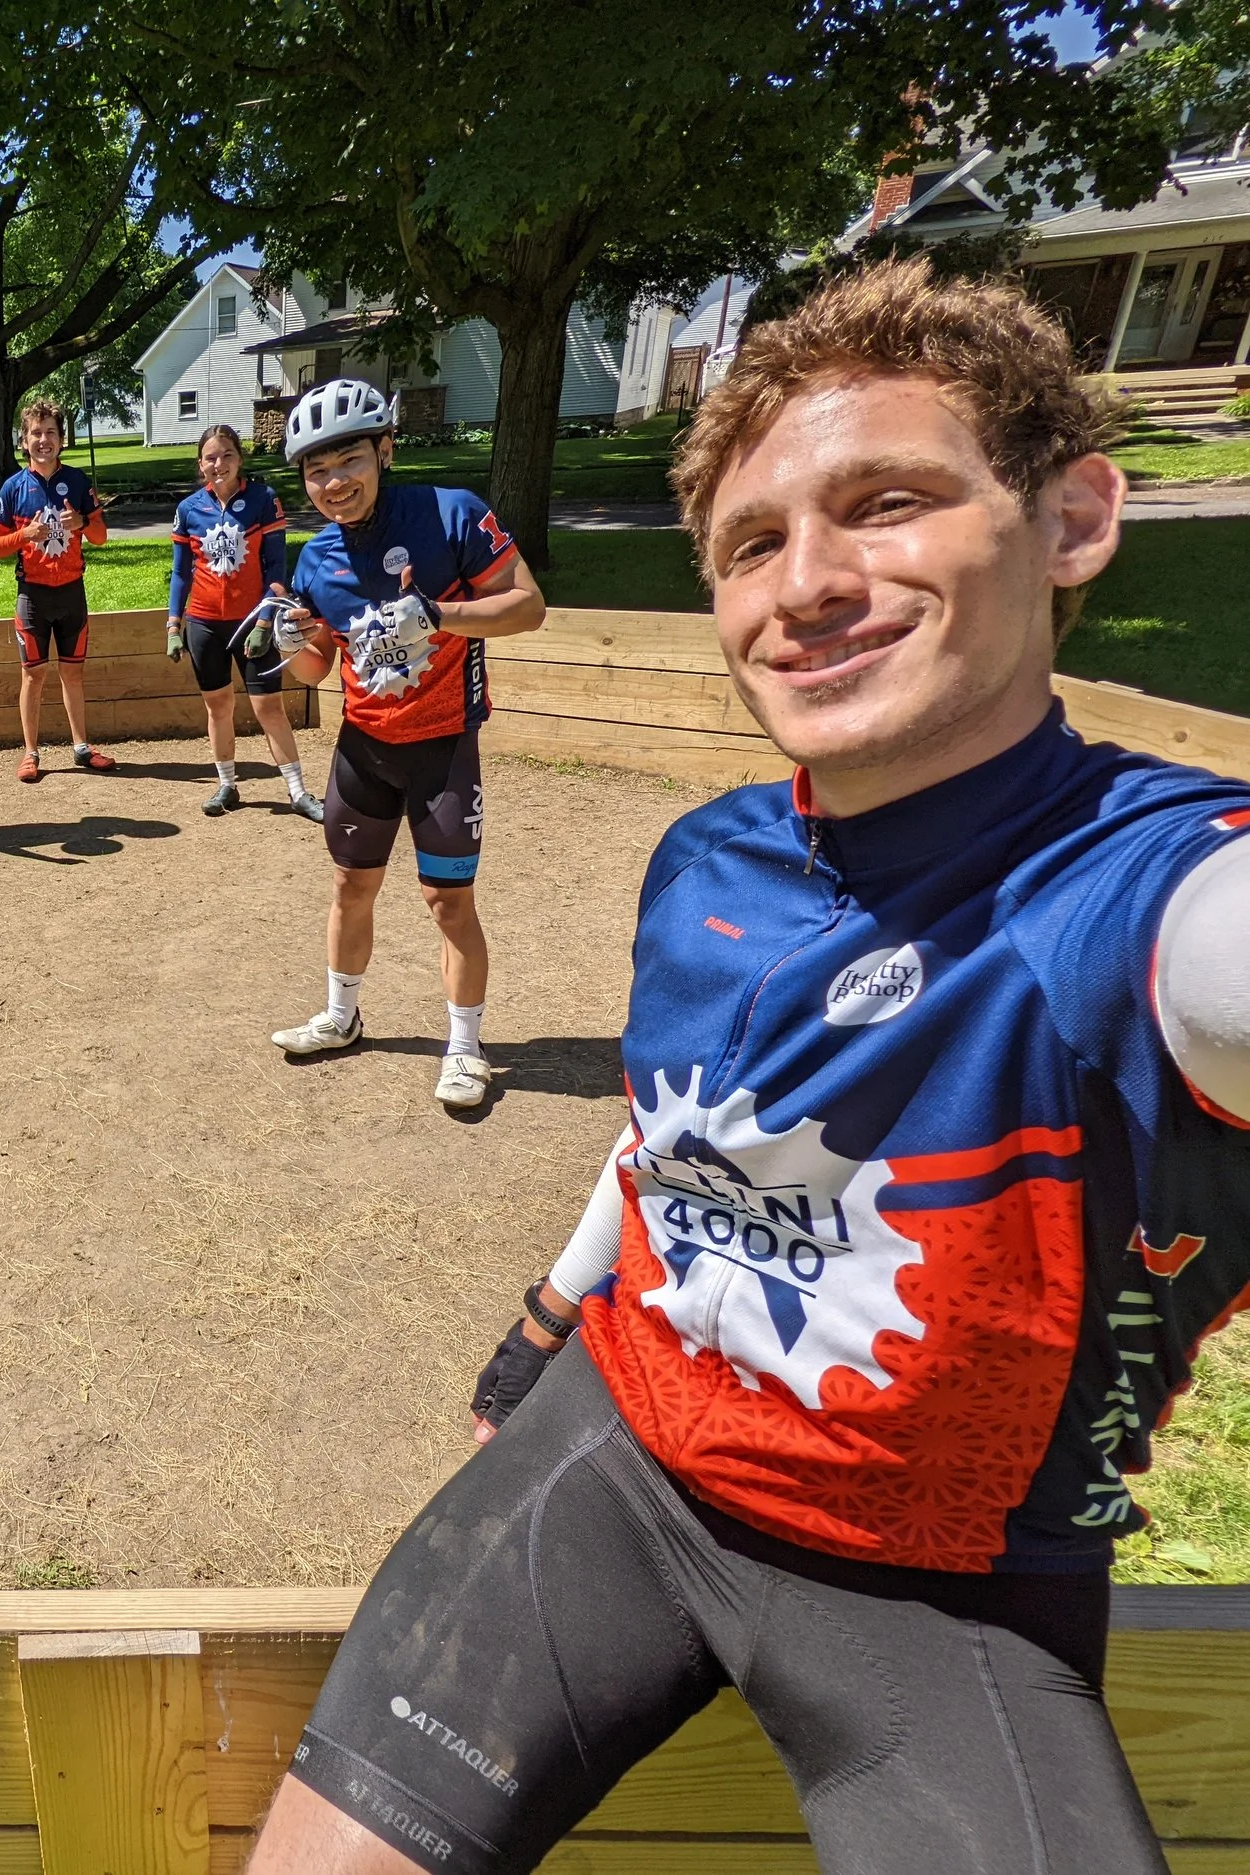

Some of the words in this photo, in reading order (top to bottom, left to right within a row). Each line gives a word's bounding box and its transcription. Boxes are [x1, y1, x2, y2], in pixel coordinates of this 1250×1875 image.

[47, 531, 65, 539] 000
[206, 539, 239, 551] ILLINI
[365, 649, 408, 668] 4000
[451, 861, 477, 876] Rap
[703, 915, 747, 942] PRIMAL
[663, 1197, 825, 1283] 4000
[407, 1710, 519, 1798] ATTAQUER
